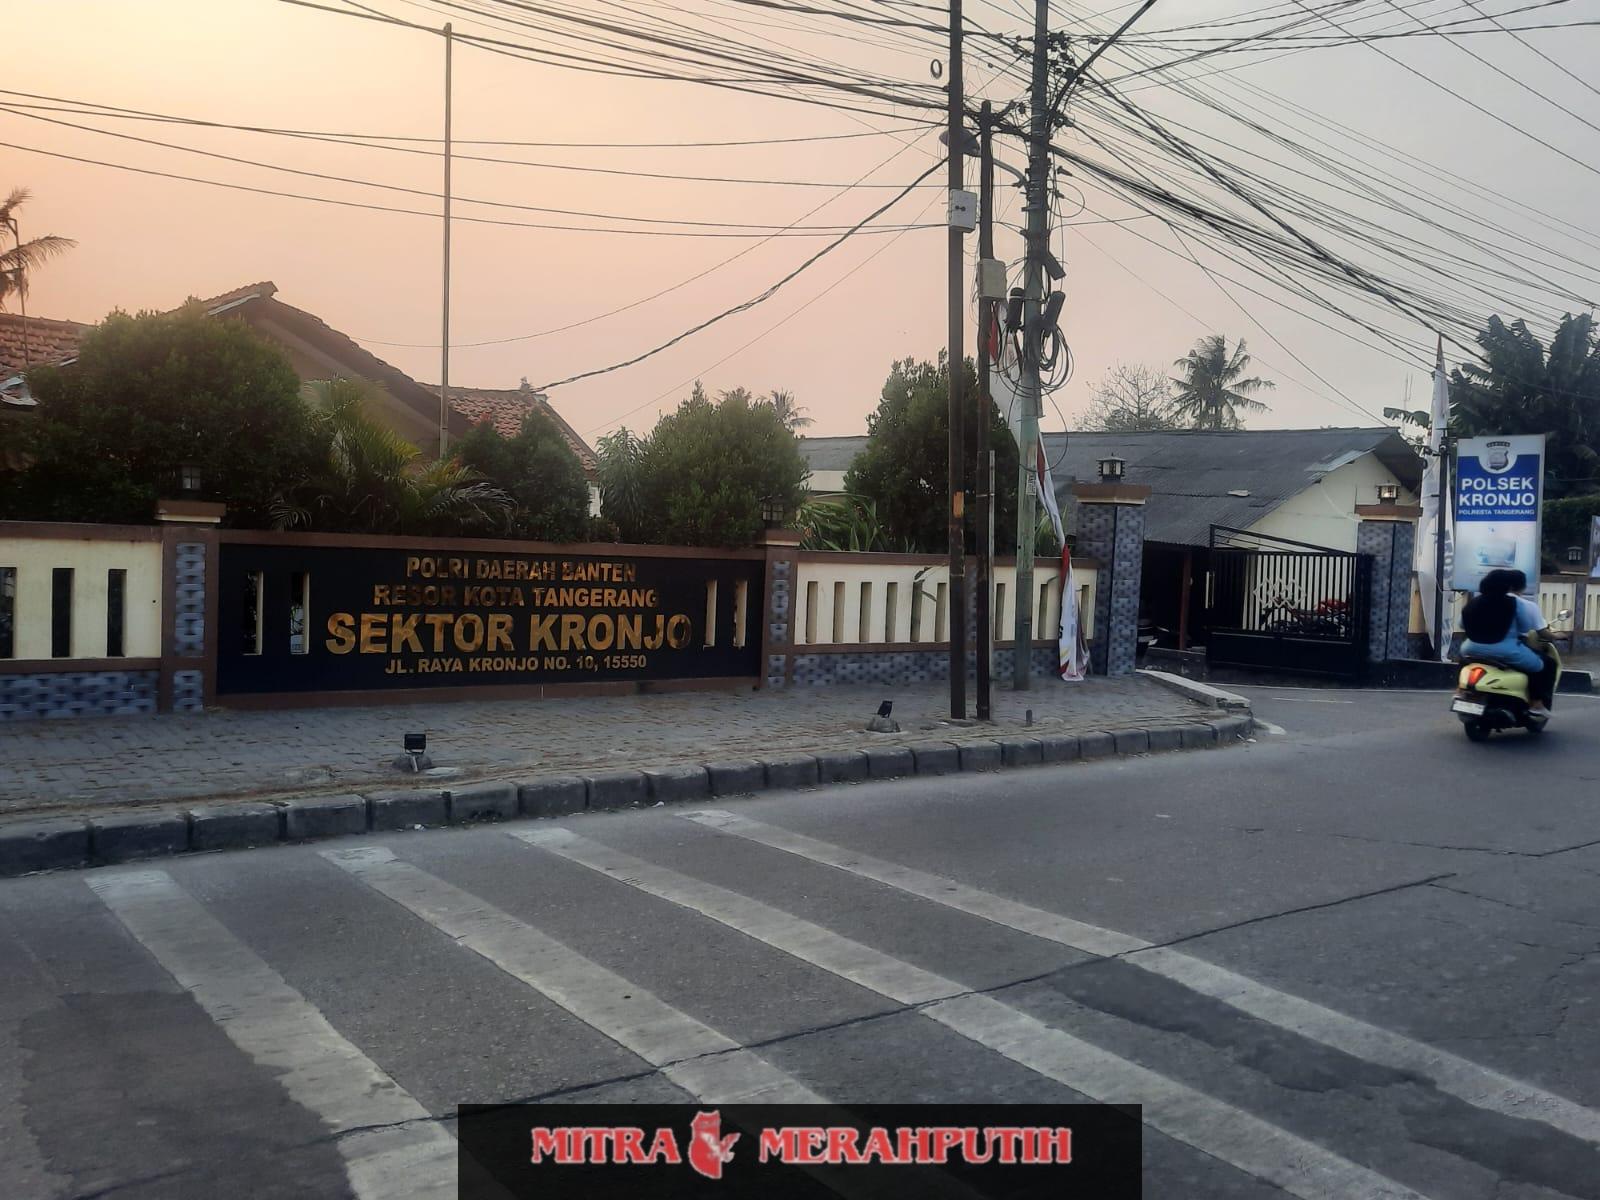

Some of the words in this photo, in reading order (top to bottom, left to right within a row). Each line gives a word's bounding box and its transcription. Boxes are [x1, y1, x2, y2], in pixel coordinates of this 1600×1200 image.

[1461, 477, 1534, 490] POLSEK
[1459, 493, 1535, 507] KRONJO
[1494, 508, 1535, 516] TANGERANG
[407, 556, 469, 579] POLRI
[476, 559, 555, 581] DAERAH
[562, 561, 636, 583] BANTEN
[373, 584, 456, 607] RESOR
[463, 585, 525, 607] KOTA
[533, 587, 658, 608] TANGERANG
[325, 612, 514, 654] SEKTOR
[529, 613, 692, 651] KRONJO
[385, 658, 414, 674] JL.
[418, 657, 463, 673] RAYA
[469, 656, 538, 672] KRONJO
[544, 656, 571, 671] NO.
[576, 655, 599, 673] 10,
[603, 655, 647, 669] 15550
